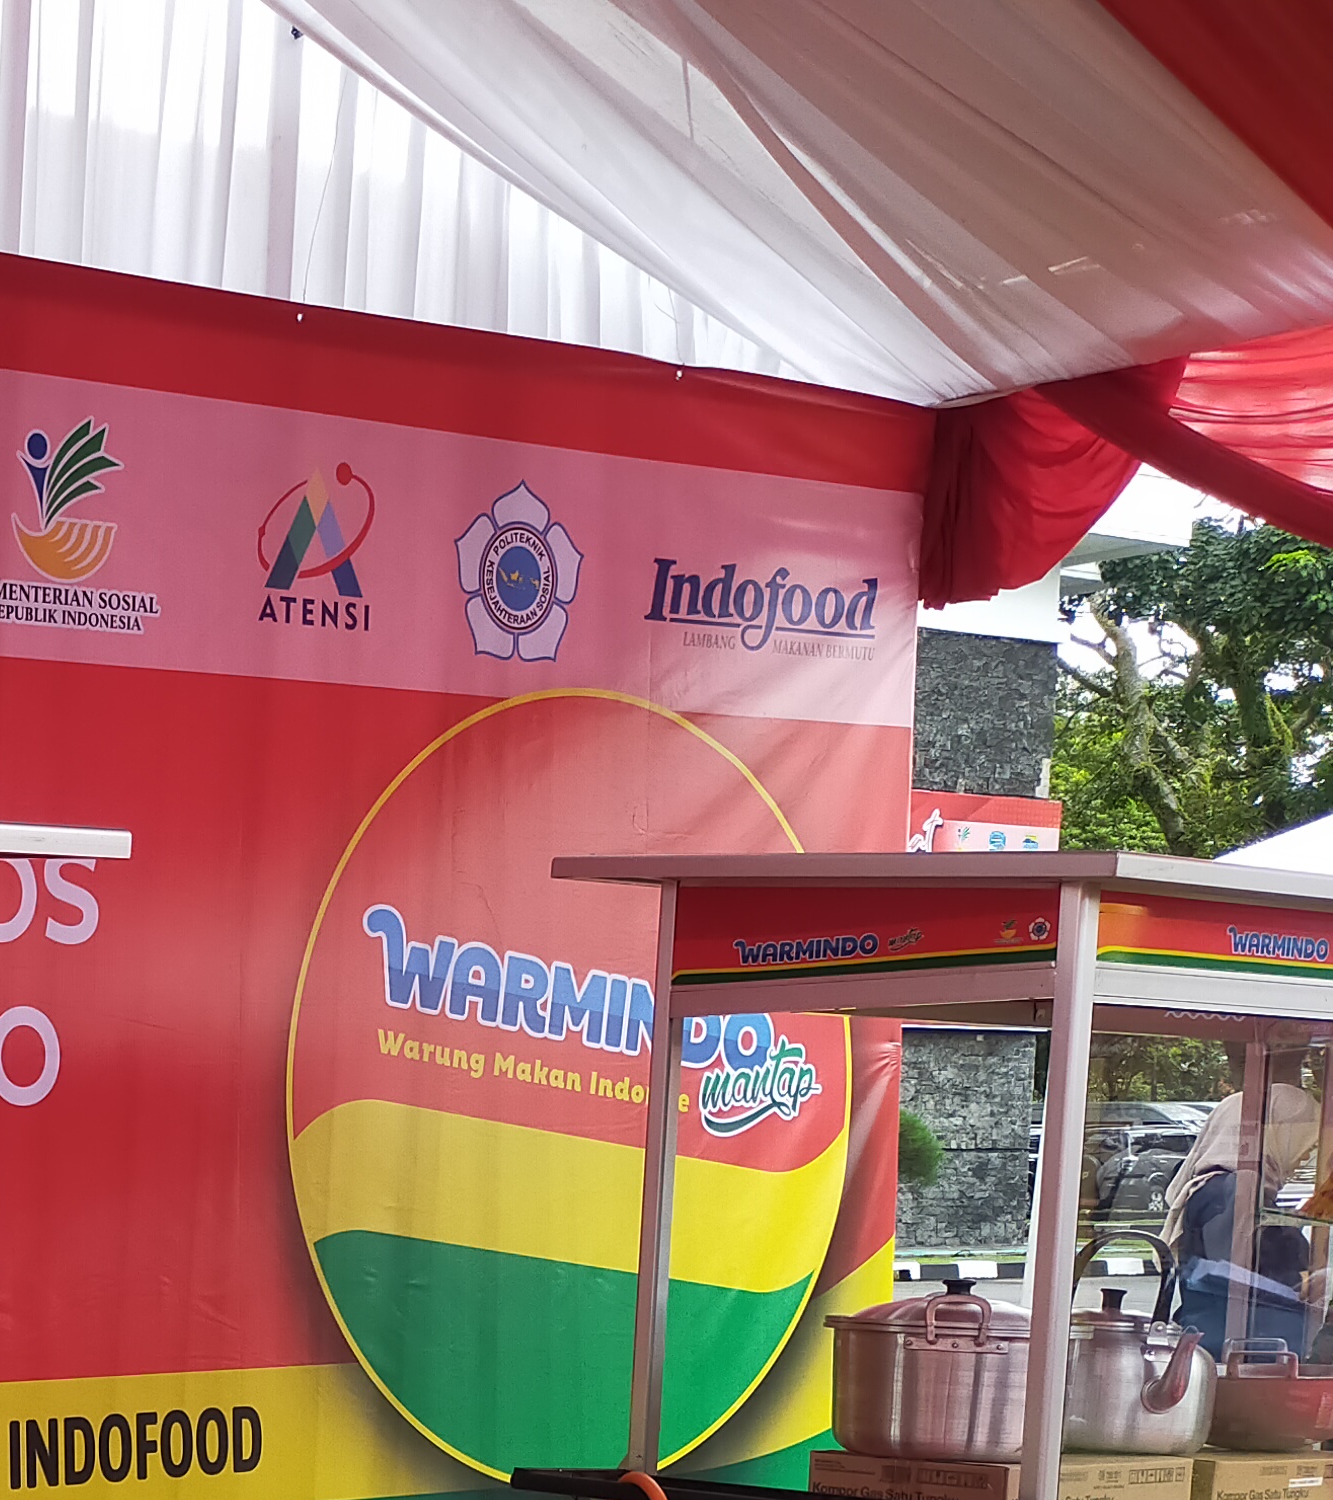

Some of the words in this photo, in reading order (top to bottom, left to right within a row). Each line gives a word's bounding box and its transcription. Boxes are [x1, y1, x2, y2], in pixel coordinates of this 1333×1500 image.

[493, 532, 546, 562] POLITEKNIK
[97, 590, 159, 615] SOSIAL
[485, 560, 538, 626] KESEJAHTERAAN
[536, 566, 552, 612] SOSIAL
[644, 557, 879, 652] Indofood
[60, 610, 142, 632] INDONESIA
[258, 595, 370, 632] ATENSI
[683, 631, 736, 651] LAMBANG
[773, 639, 823, 658] MAKANAN
[825, 643, 875, 660] BERMUTU
[733, 934, 880, 966] WARMINDO
[1227, 925, 1330, 962] WARMINDO
[377, 1028, 486, 1077] Warung
[493, 1055, 582, 1092] Makan
[590, 1070, 689, 1114] Indoe
[700, 1040, 822, 1137] mantap
[9, 1406, 262, 1490] INDOFOOD
